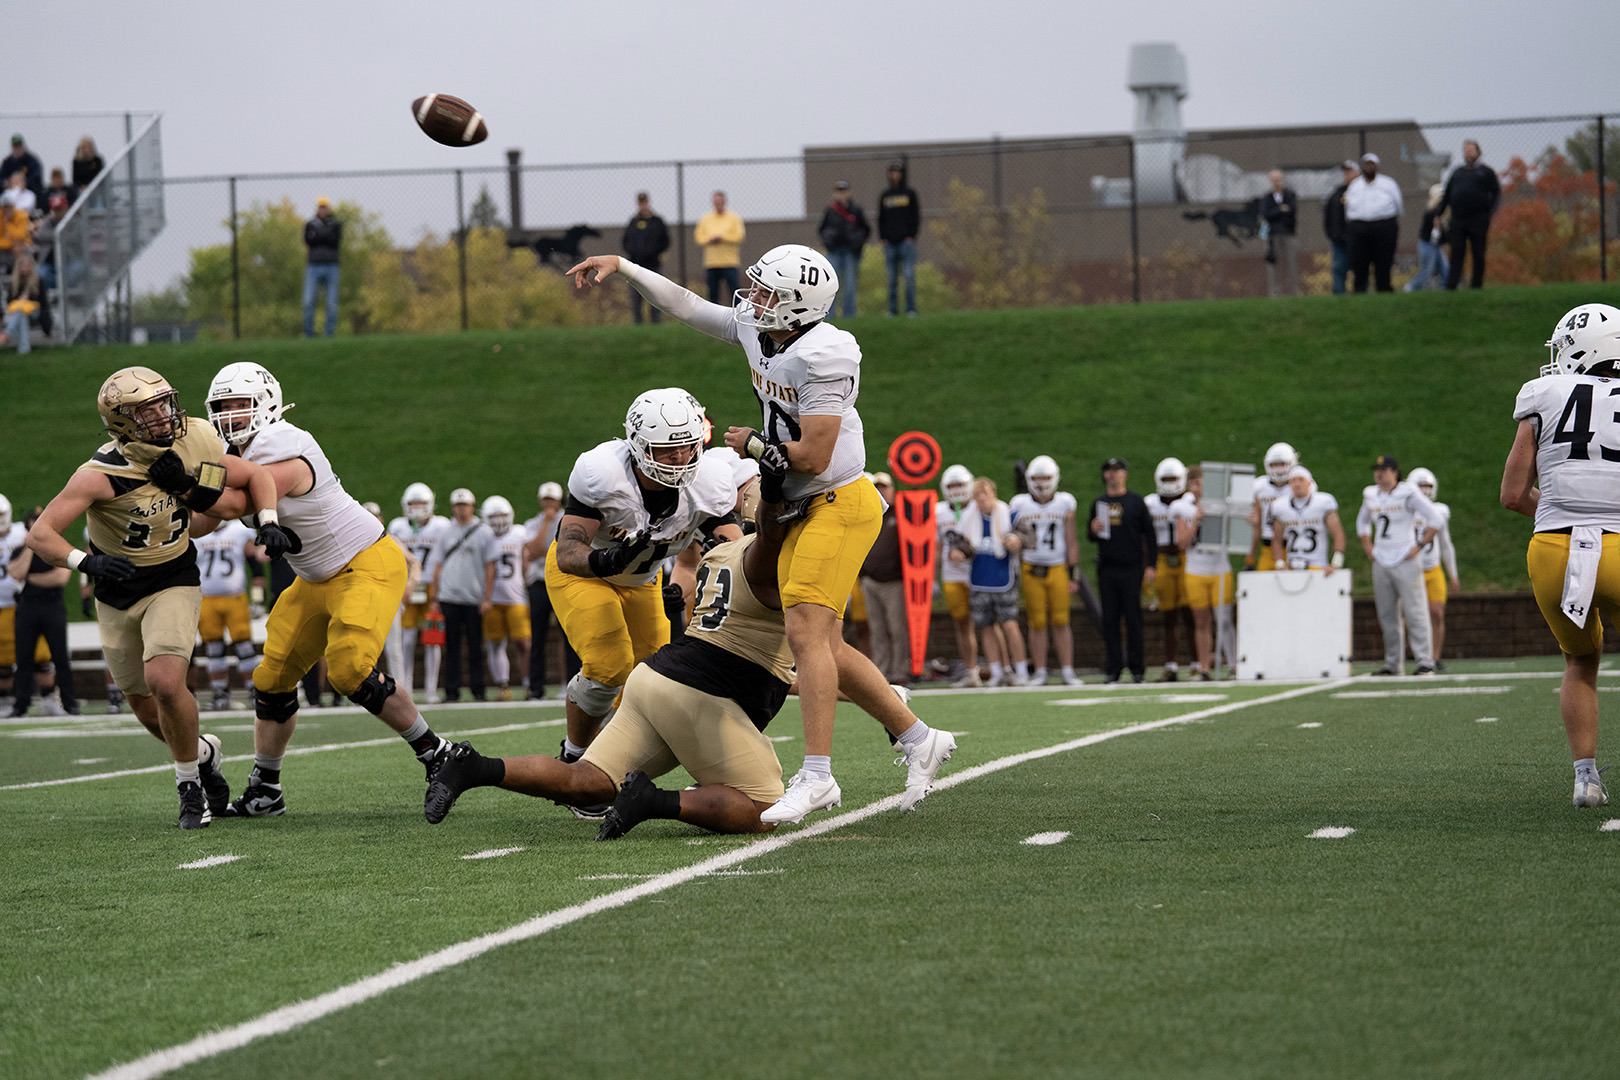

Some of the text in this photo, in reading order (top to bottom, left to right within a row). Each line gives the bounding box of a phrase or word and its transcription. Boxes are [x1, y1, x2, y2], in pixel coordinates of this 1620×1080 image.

[799, 264, 819, 287] 10
[1565, 312, 1590, 331] 43
[1289, 528, 1317, 553] 23
[203, 548, 234, 578] 75
